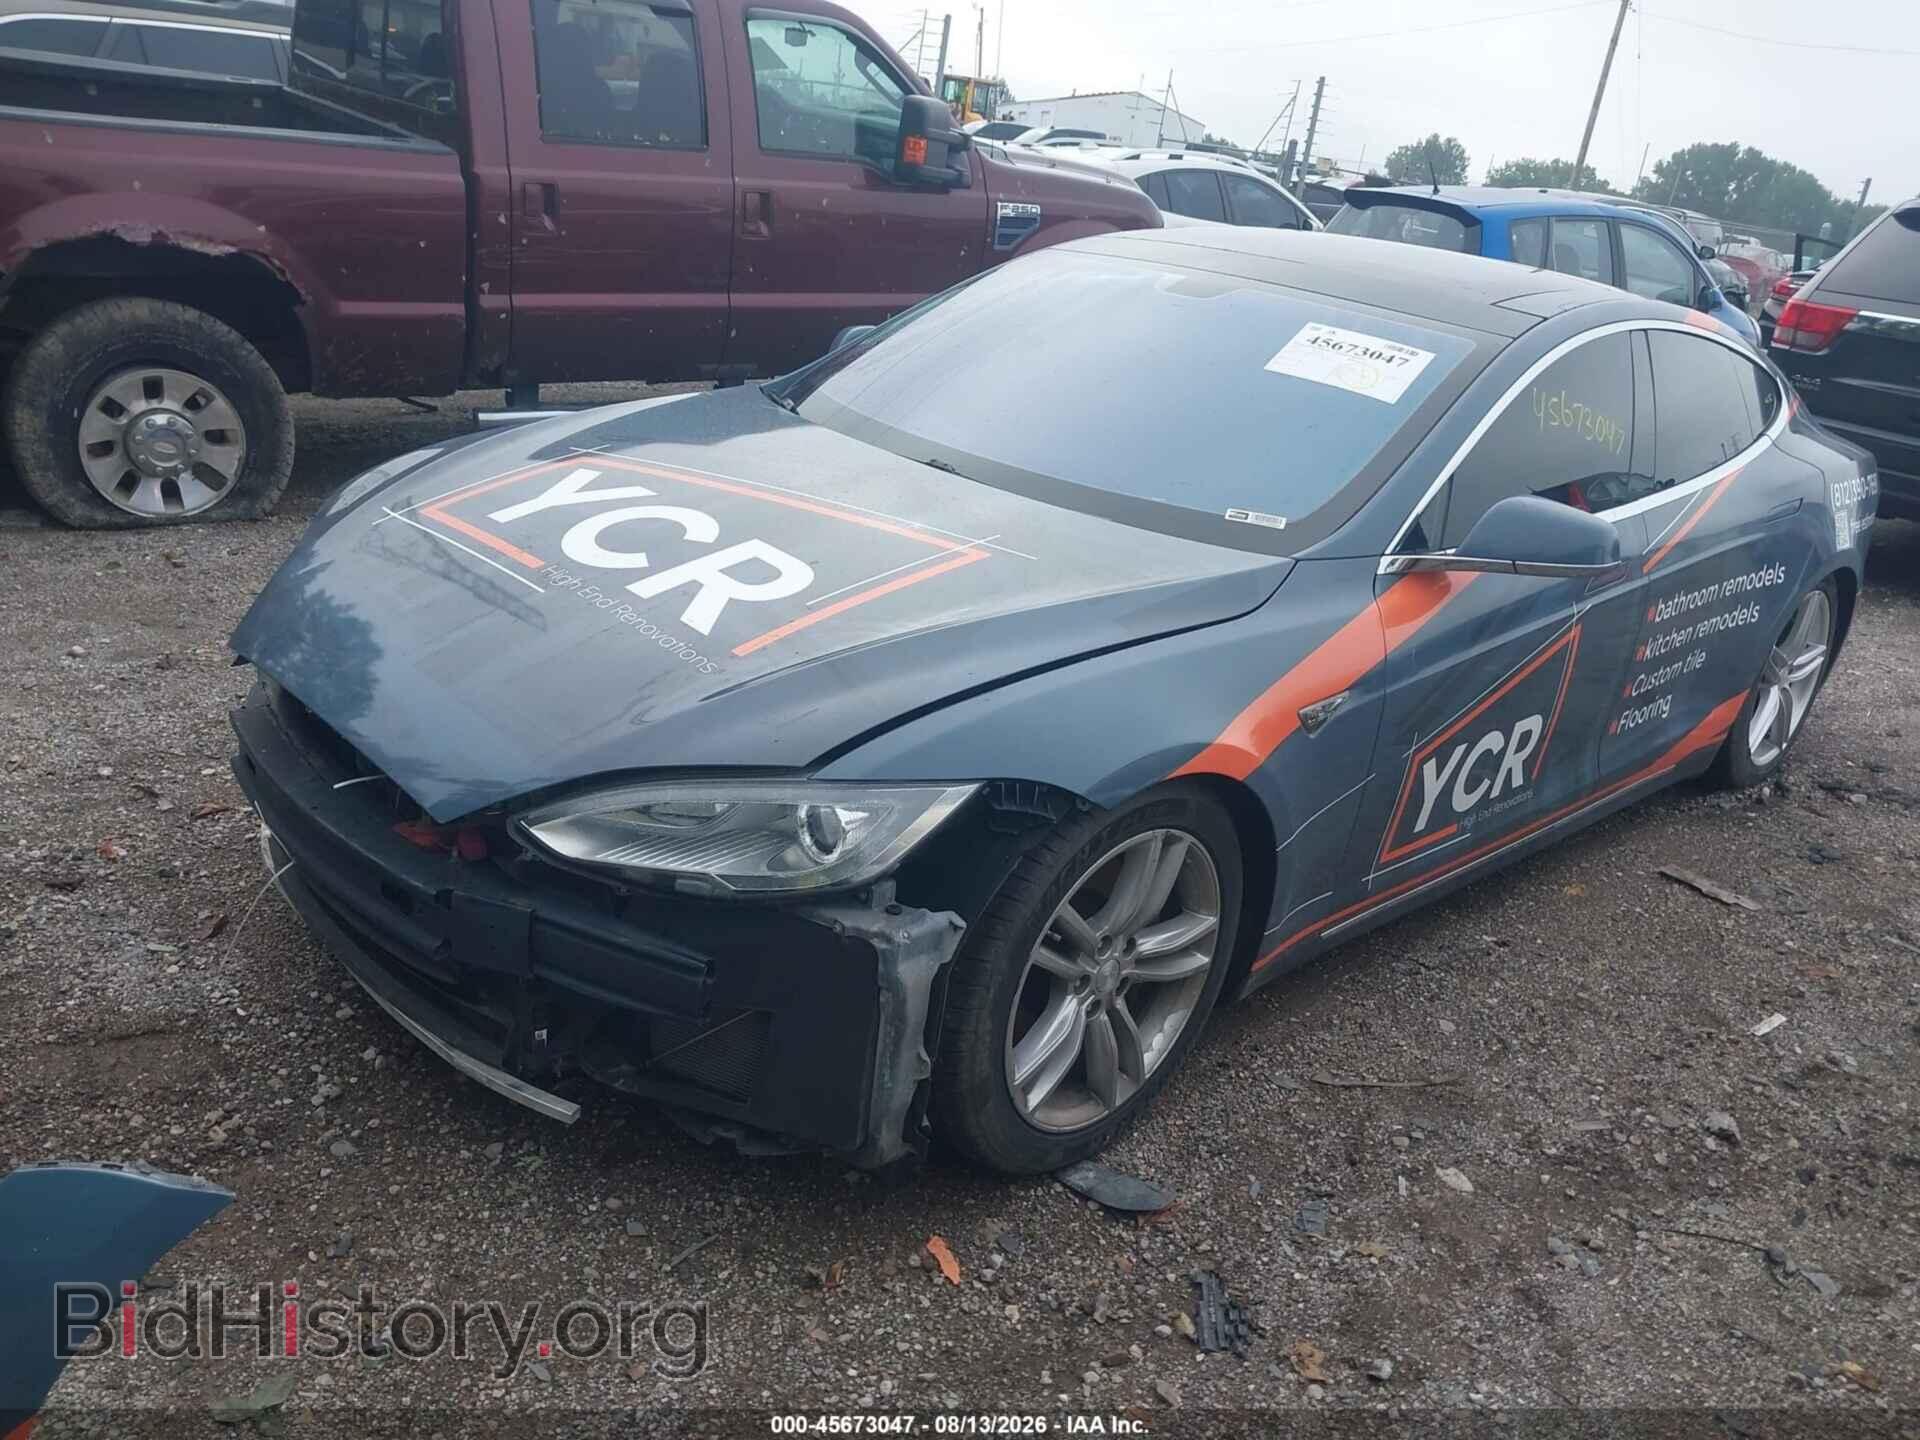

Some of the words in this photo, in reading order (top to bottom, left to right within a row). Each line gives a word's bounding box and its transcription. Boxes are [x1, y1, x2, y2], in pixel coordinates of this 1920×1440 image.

[1305, 335, 1411, 368] 45673047
[1533, 387, 1626, 455] 45673047
[487, 467, 815, 636] YCR
[540, 563, 583, 592] High
[577, 584, 621, 609] End
[610, 603, 718, 674] Renovations
[1654, 582, 1720, 624] bathroom
[1720, 561, 1787, 600] remodels
[1642, 625, 1693, 663] kitchen
[1693, 600, 1761, 639] remodels
[1630, 660, 1684, 698] Custom
[1682, 649, 1707, 674] tile
[1615, 693, 1673, 736] Flooring
[1412, 713, 1544, 834] YCR
